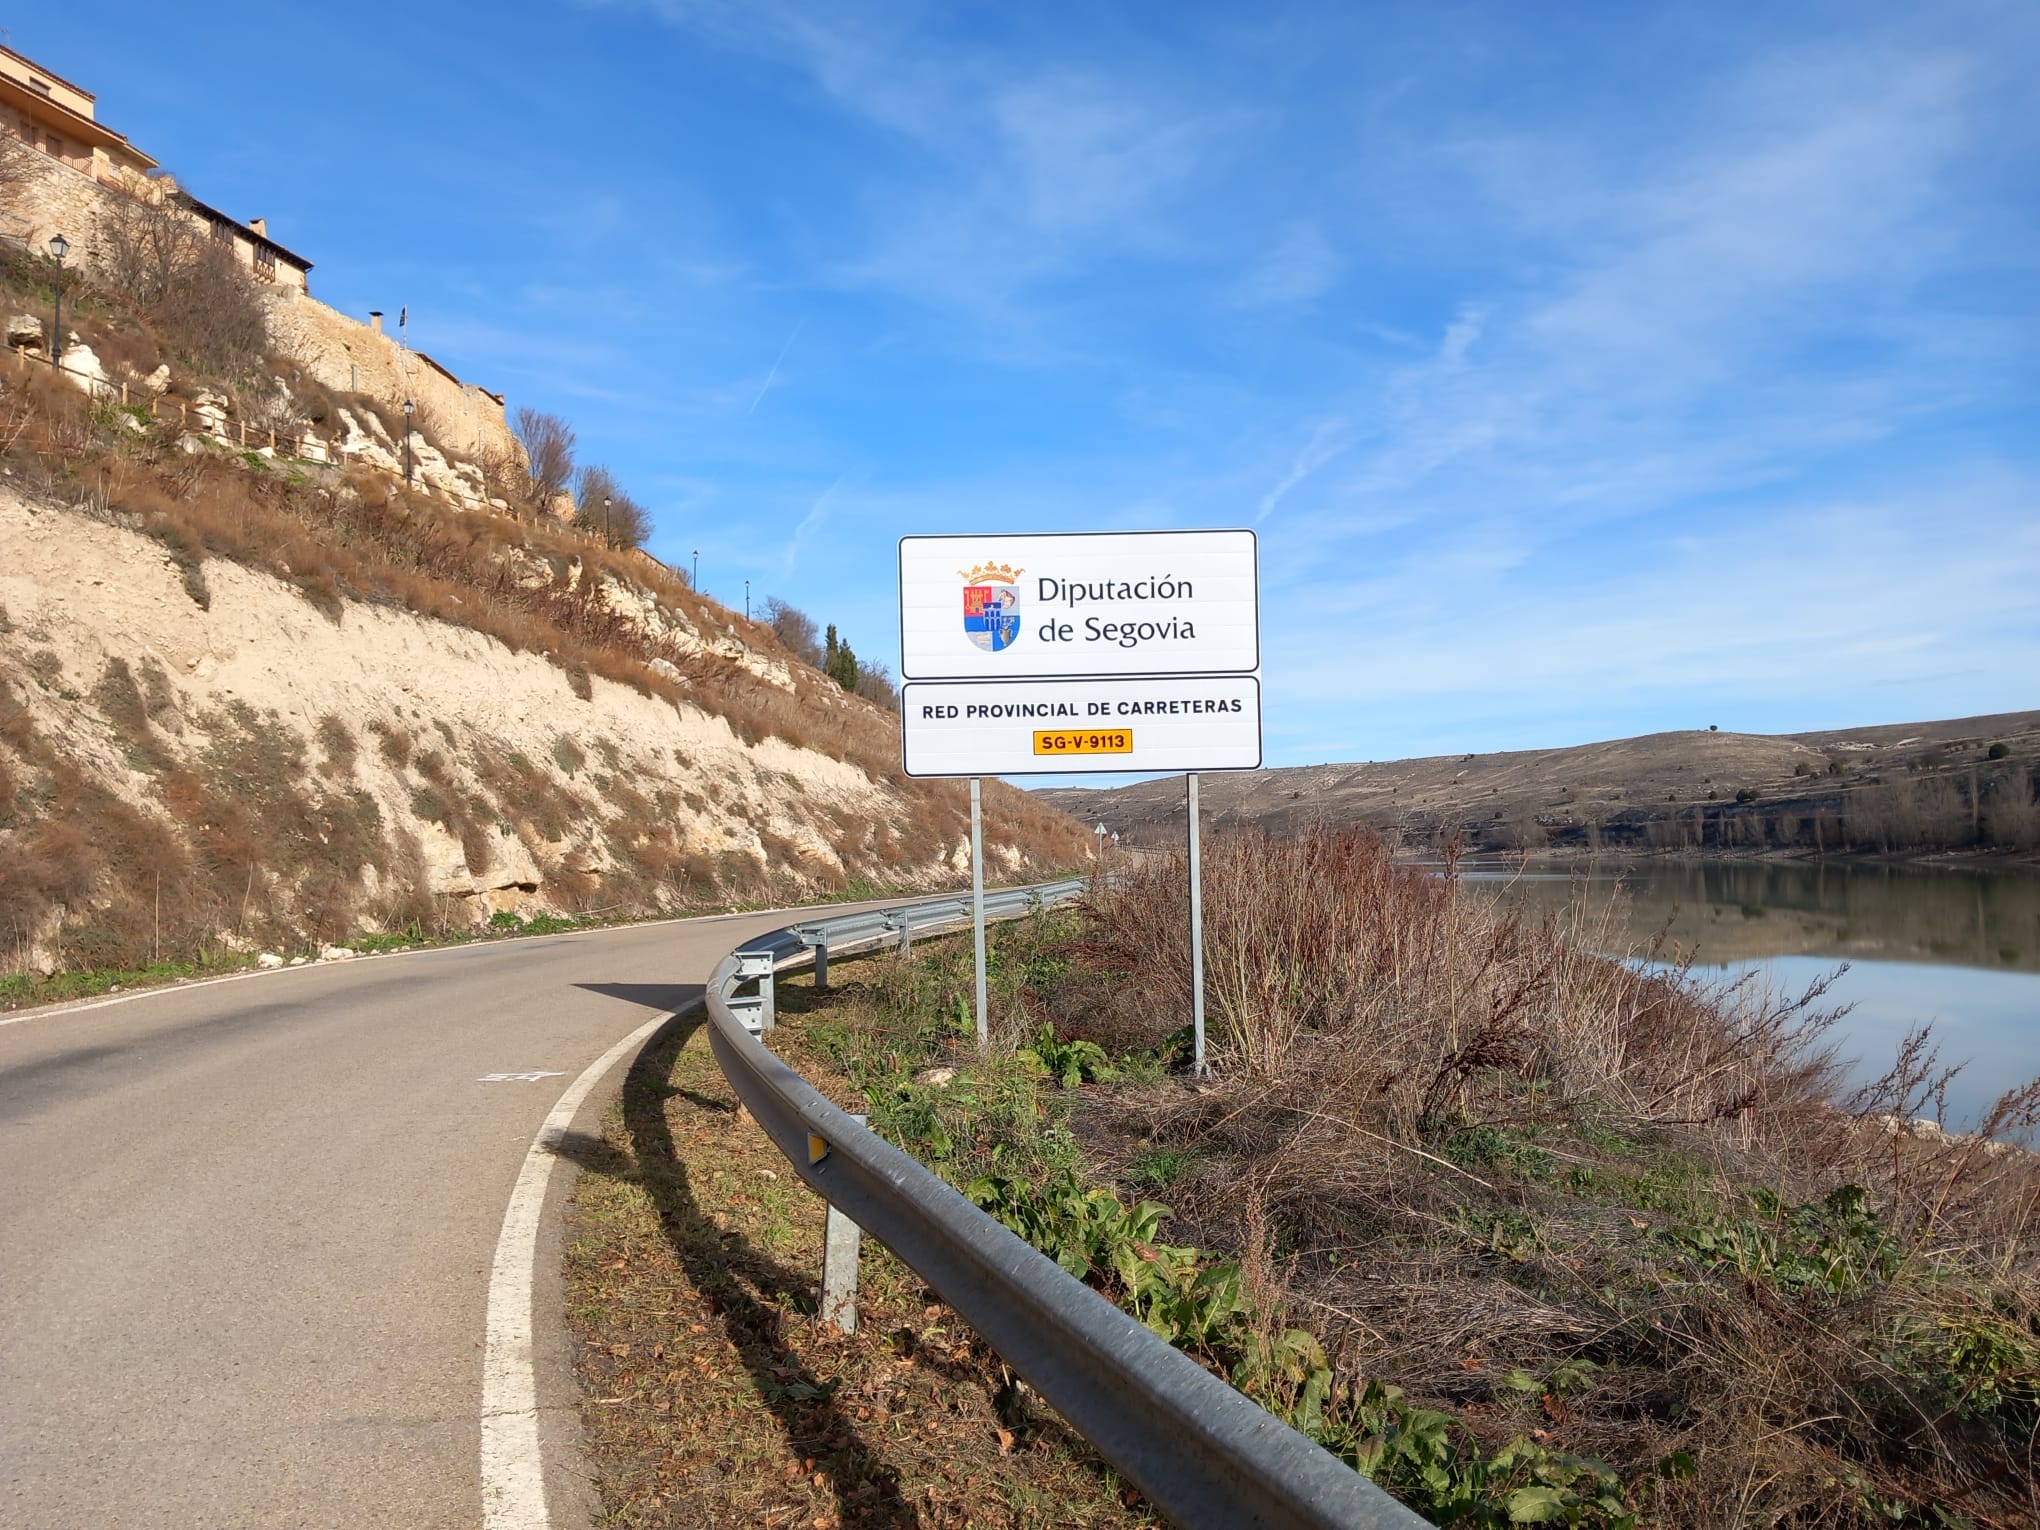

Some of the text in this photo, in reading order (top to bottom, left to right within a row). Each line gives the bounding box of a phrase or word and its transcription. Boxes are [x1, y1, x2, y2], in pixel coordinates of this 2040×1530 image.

[1038, 573, 1193, 608] Diputación
[1038, 616, 1196, 648] de Segovia
[922, 698, 1242, 719] RED PROVINCIAL DE CARRETERAS
[1042, 734, 1125, 750] SG-V-9113
